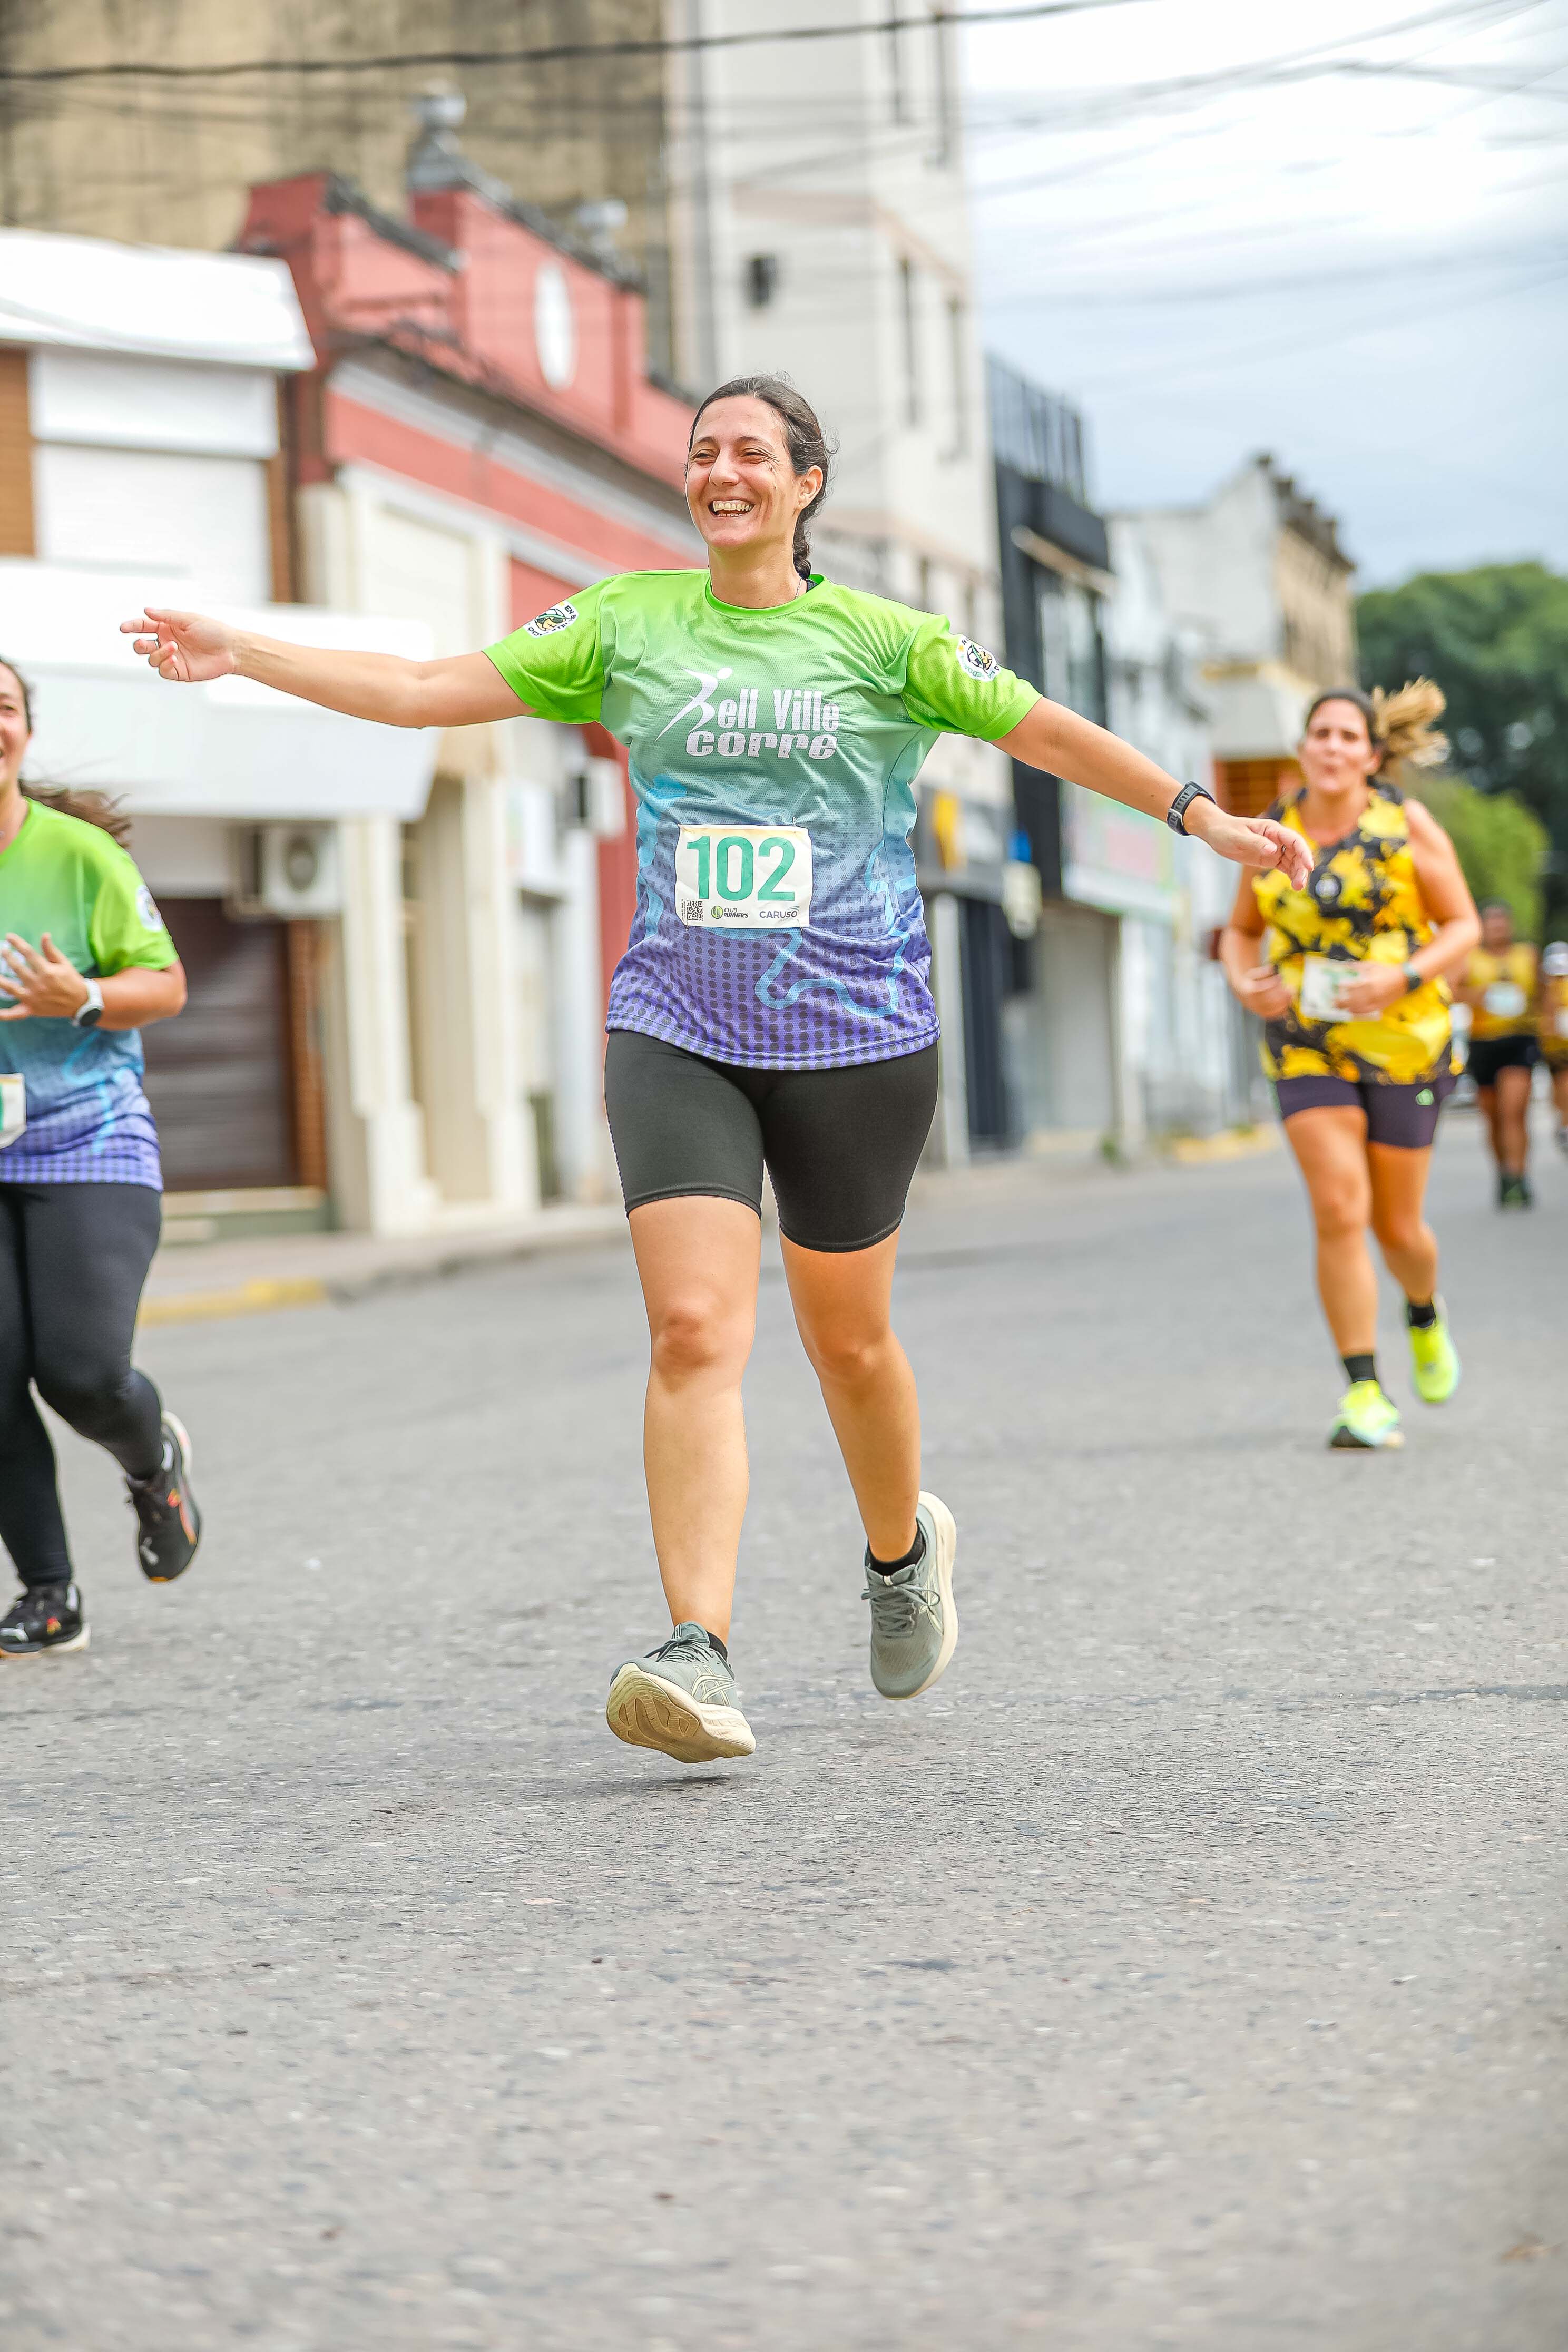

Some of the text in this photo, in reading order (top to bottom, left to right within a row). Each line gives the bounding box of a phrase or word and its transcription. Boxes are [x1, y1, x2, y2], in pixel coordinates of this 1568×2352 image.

[773, 688, 840, 732] Ville
[685, 731, 838, 760] corre
[687, 836, 795, 901] 102
[759, 910, 798, 919] CARUSO
